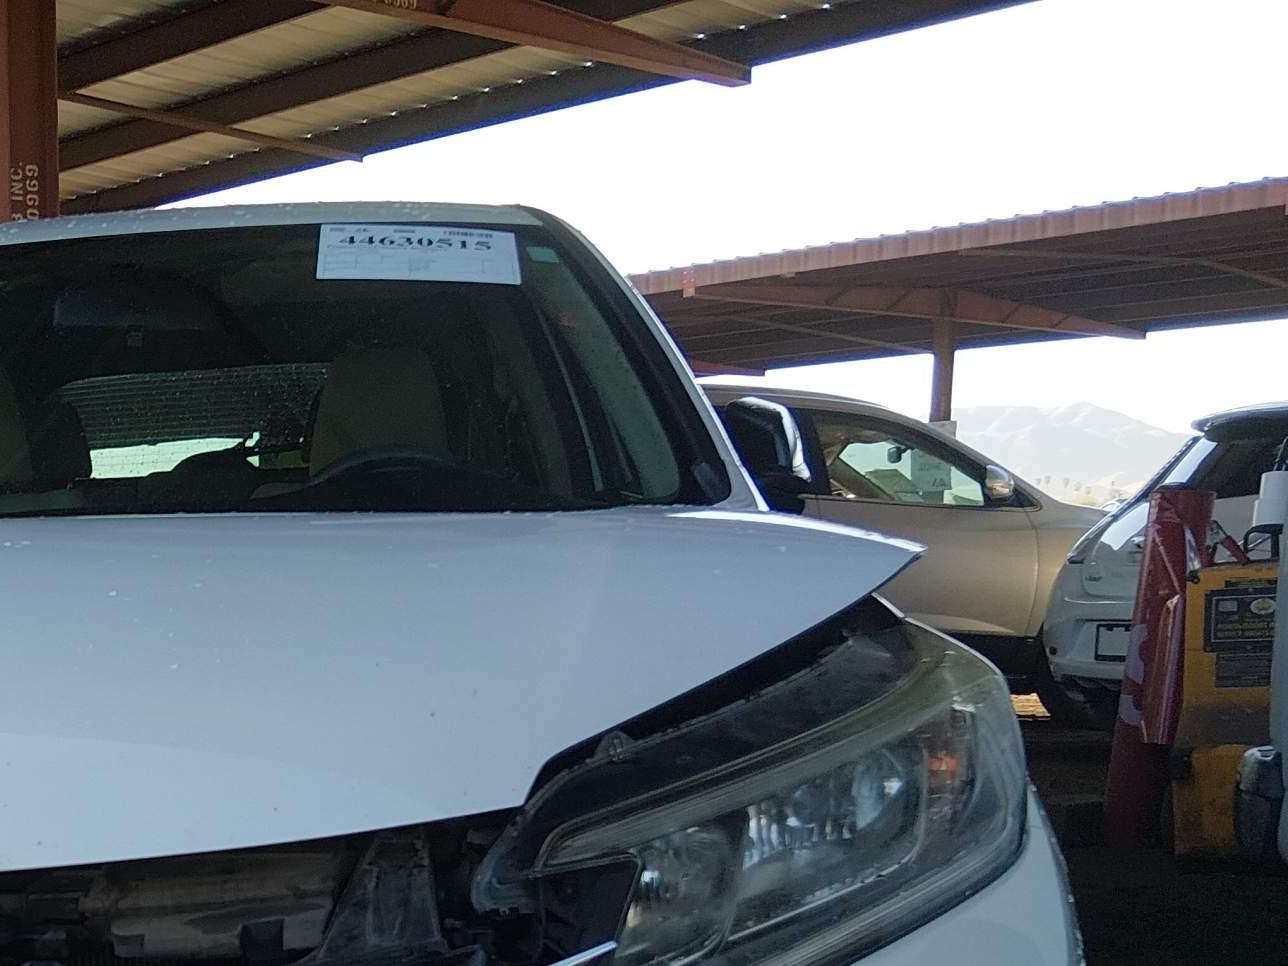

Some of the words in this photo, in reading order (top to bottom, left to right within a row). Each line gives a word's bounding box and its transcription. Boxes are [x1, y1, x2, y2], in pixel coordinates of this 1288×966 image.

[10, 161, 24, 201] INC.
[25, 164, 40, 220] 0969
[339, 235, 493, 251] 44630515
